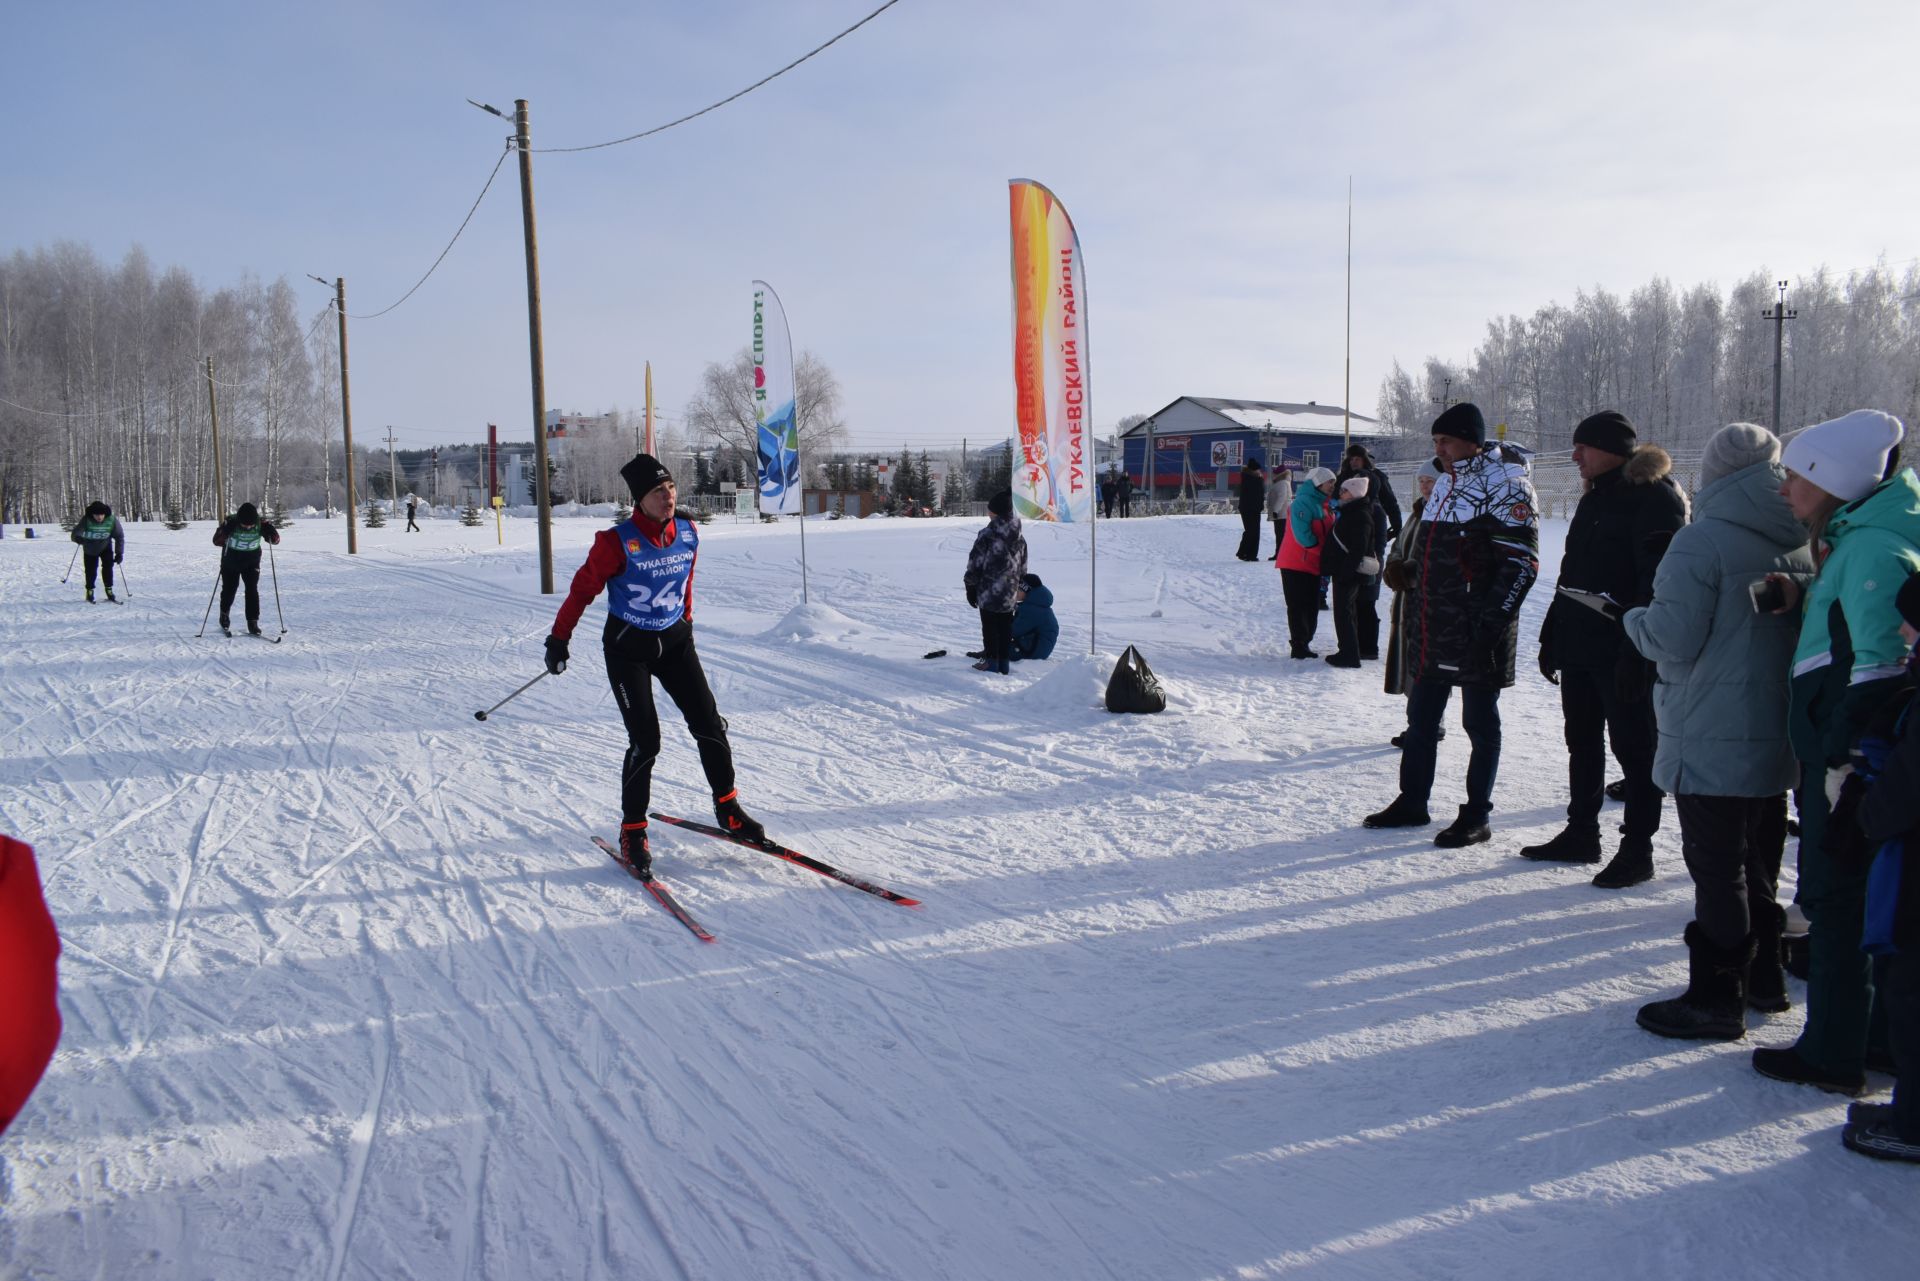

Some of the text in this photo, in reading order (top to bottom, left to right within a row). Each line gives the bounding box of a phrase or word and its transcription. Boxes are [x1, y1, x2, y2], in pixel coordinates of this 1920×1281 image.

[1058, 248, 1083, 494] ТУКАЕВСКИЙ РАЙОН
[635, 550, 694, 571] ТУКАЕВСКИЙ
[652, 564, 684, 578] РАЙОН
